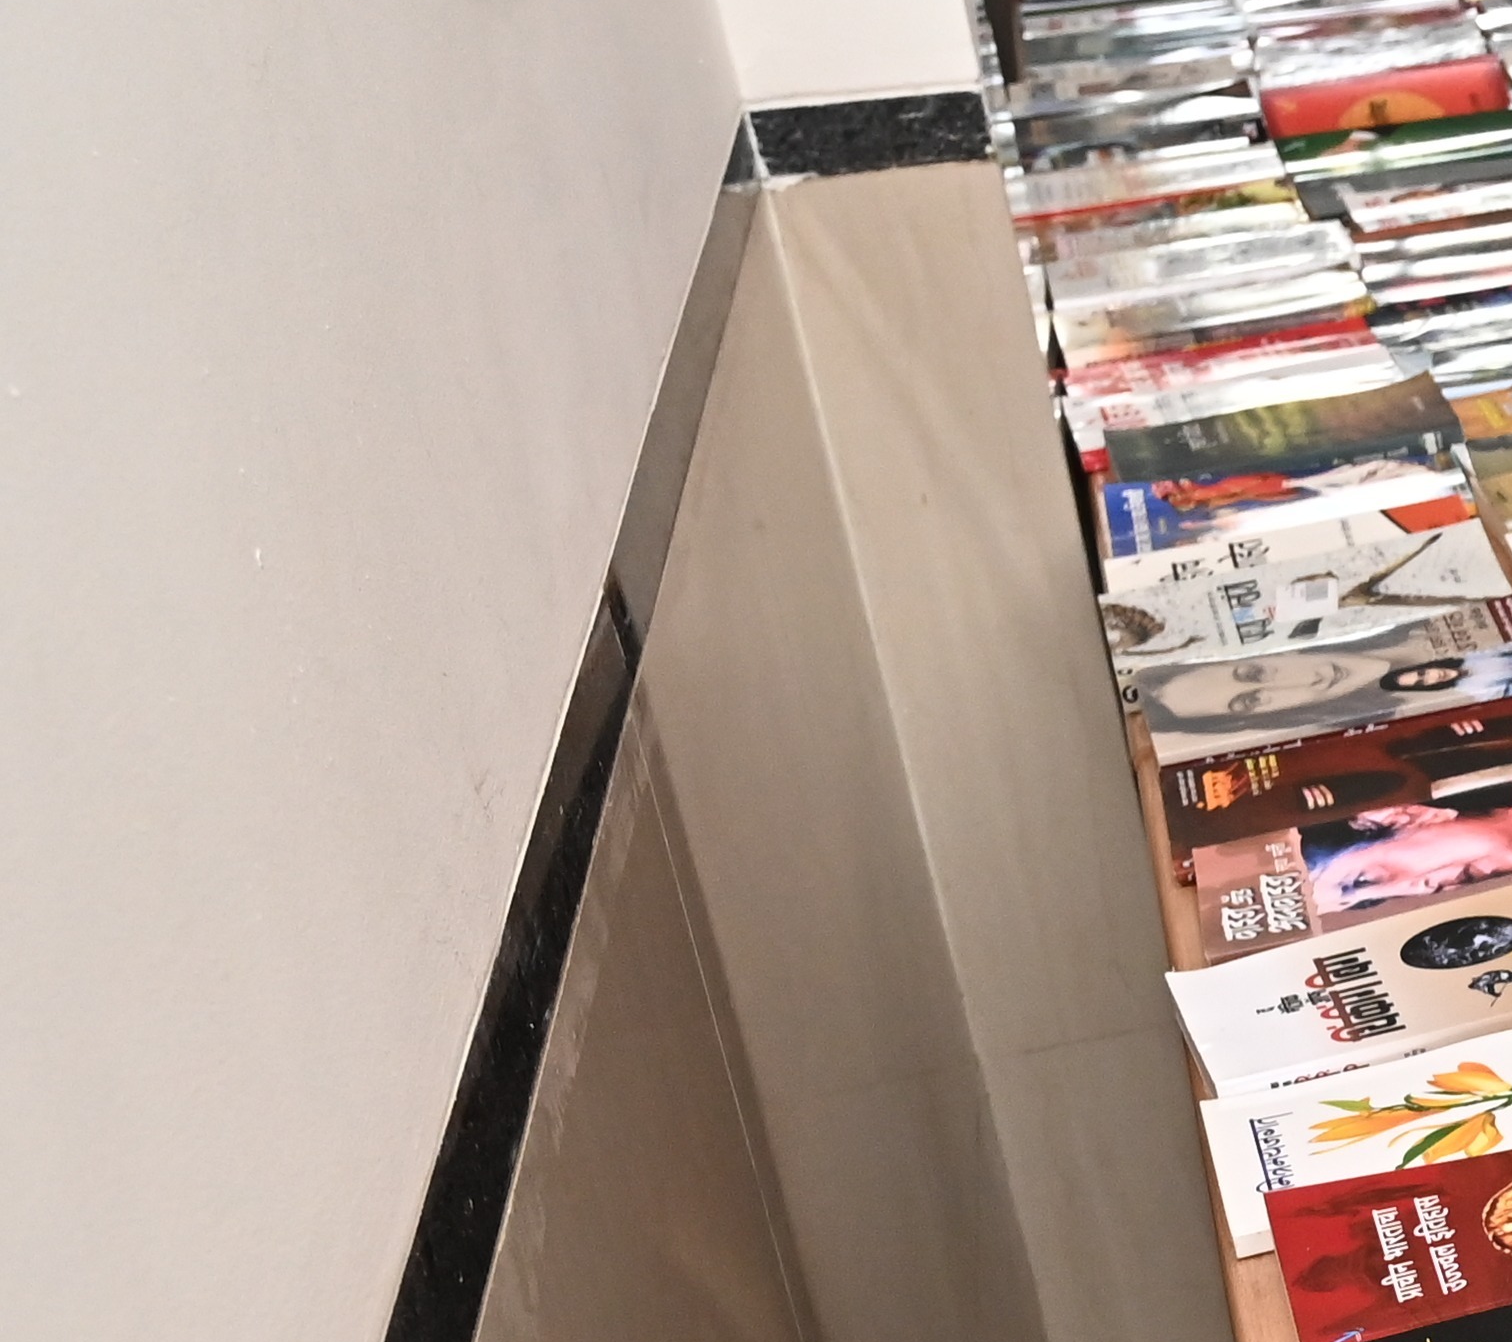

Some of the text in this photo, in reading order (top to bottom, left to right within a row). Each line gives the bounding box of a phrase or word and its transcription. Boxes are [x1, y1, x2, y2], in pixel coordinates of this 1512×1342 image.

[1371, 1207, 1423, 1303] प्राचीन भारताचा
[1413, 1195, 1467, 1295] उज्ज्वल इतिहास
